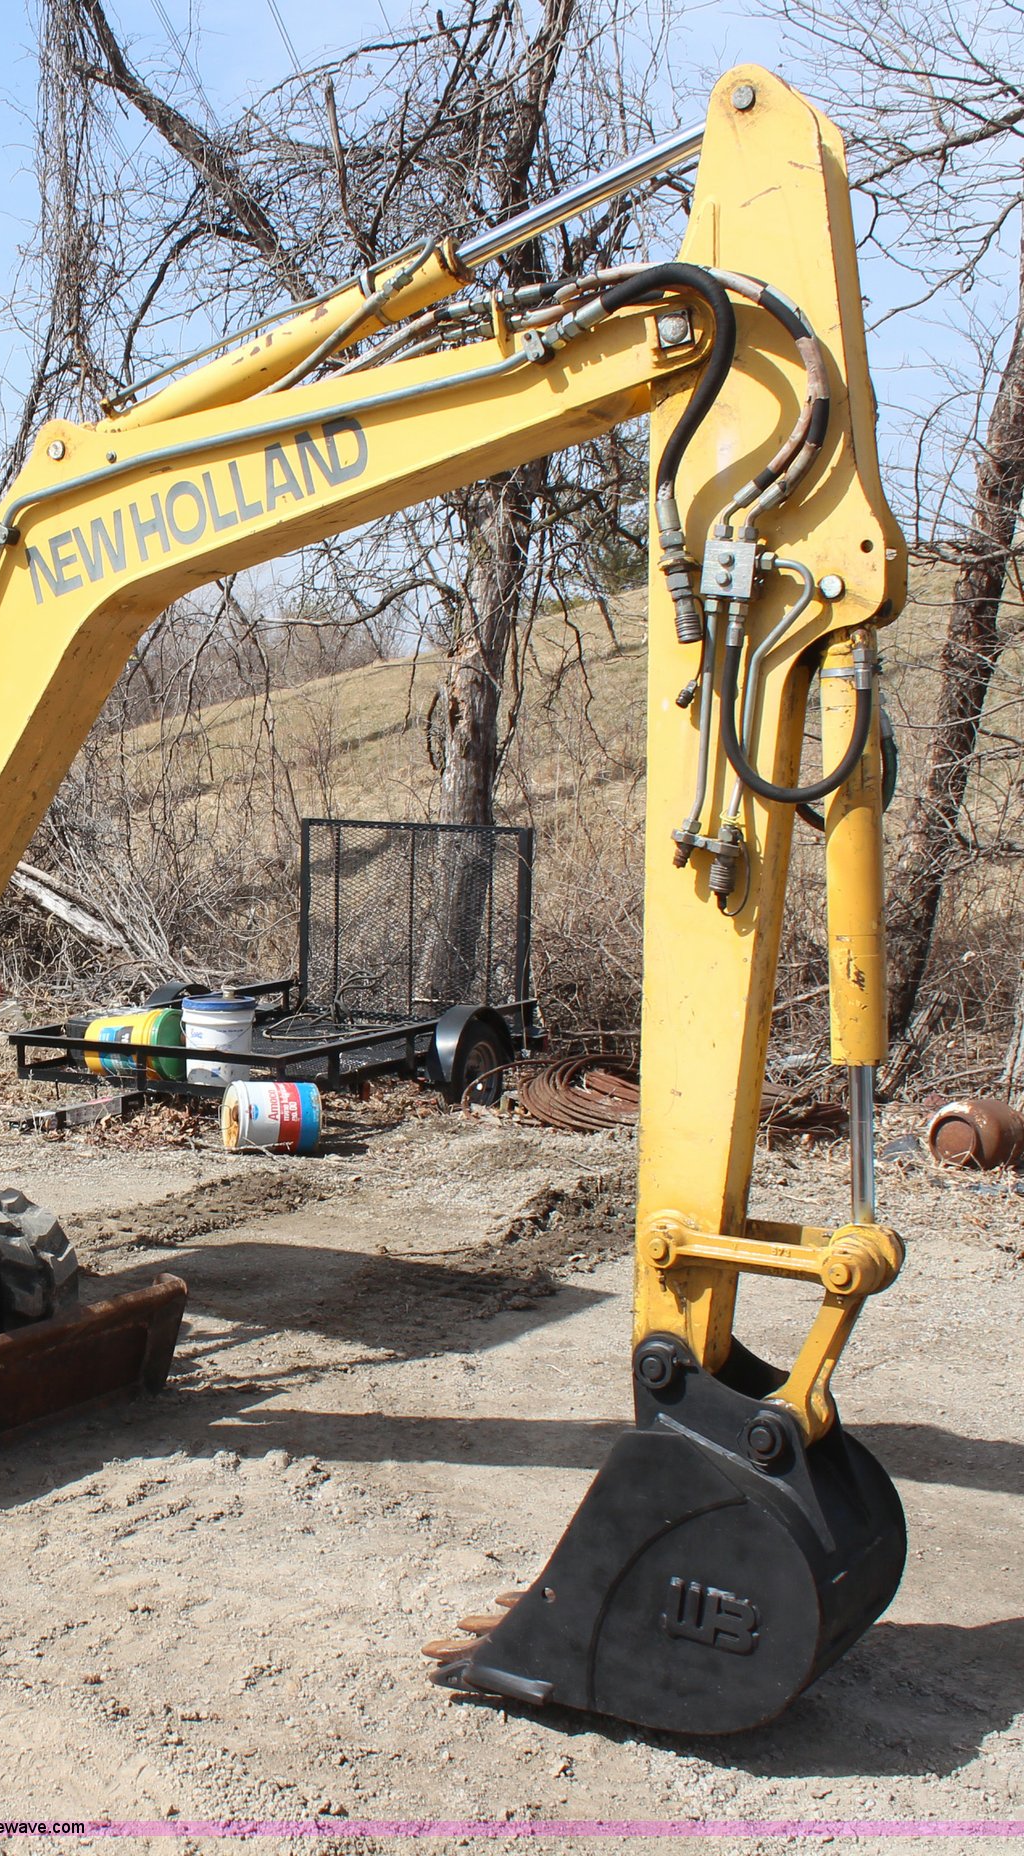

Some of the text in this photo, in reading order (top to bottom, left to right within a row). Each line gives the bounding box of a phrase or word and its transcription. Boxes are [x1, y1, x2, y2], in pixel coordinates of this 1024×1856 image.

[26, 416, 369, 605] NEW HOLLAND
[267, 1089, 279, 1121] Amoco
